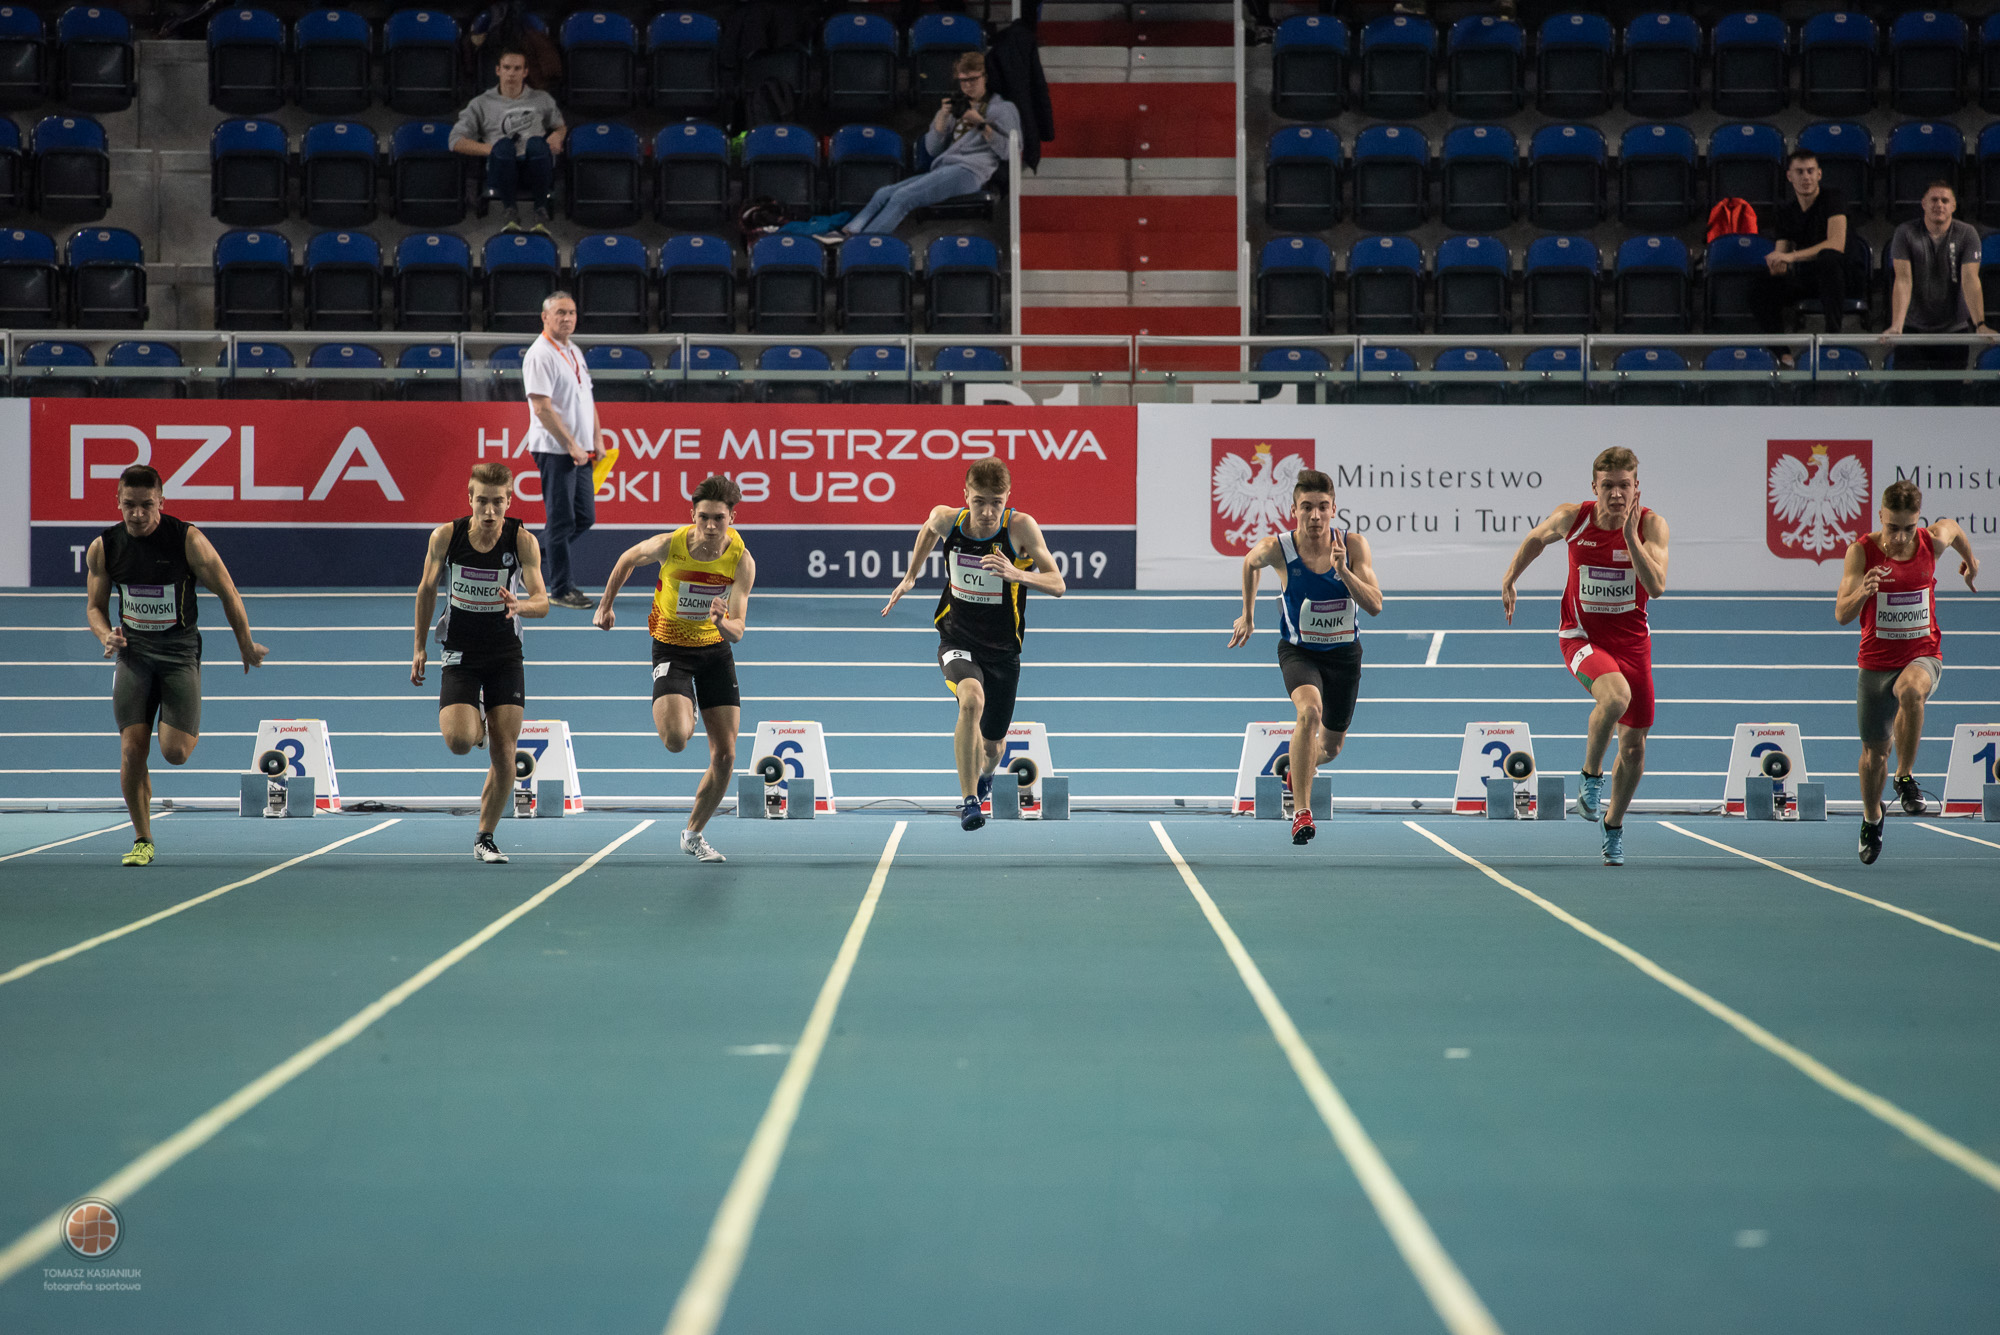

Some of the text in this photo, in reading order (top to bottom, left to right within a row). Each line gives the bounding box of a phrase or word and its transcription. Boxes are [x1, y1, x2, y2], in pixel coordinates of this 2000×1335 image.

[718, 428, 1107, 460] MISTRZOSTWA
[70, 424, 405, 501] PZLA
[789, 471, 896, 502] U20
[1338, 464, 1542, 489] Ministerstwo
[1896, 465, 2000, 489] Minist
[1337, 508, 1438, 534] Sportu
[1455, 509, 1460, 533] i
[808, 550, 881, 578] 8-10
[453, 581, 505, 597] CZARNECK
[963, 573, 985, 587] CYL
[1581, 584, 1634, 597] ŁUPIŃSKI
[124, 599, 174, 614] MAKOWSKI
[1878, 608, 1928, 622] PROKOPOWICZ
[1310, 616, 1344, 628] JANIK
[1269, 728, 1294, 736] polani
[517, 739, 548, 788] 7
[773, 740, 804, 789] 6
[1481, 741, 1511, 788] 3
[1973, 743, 1995, 784] 1
